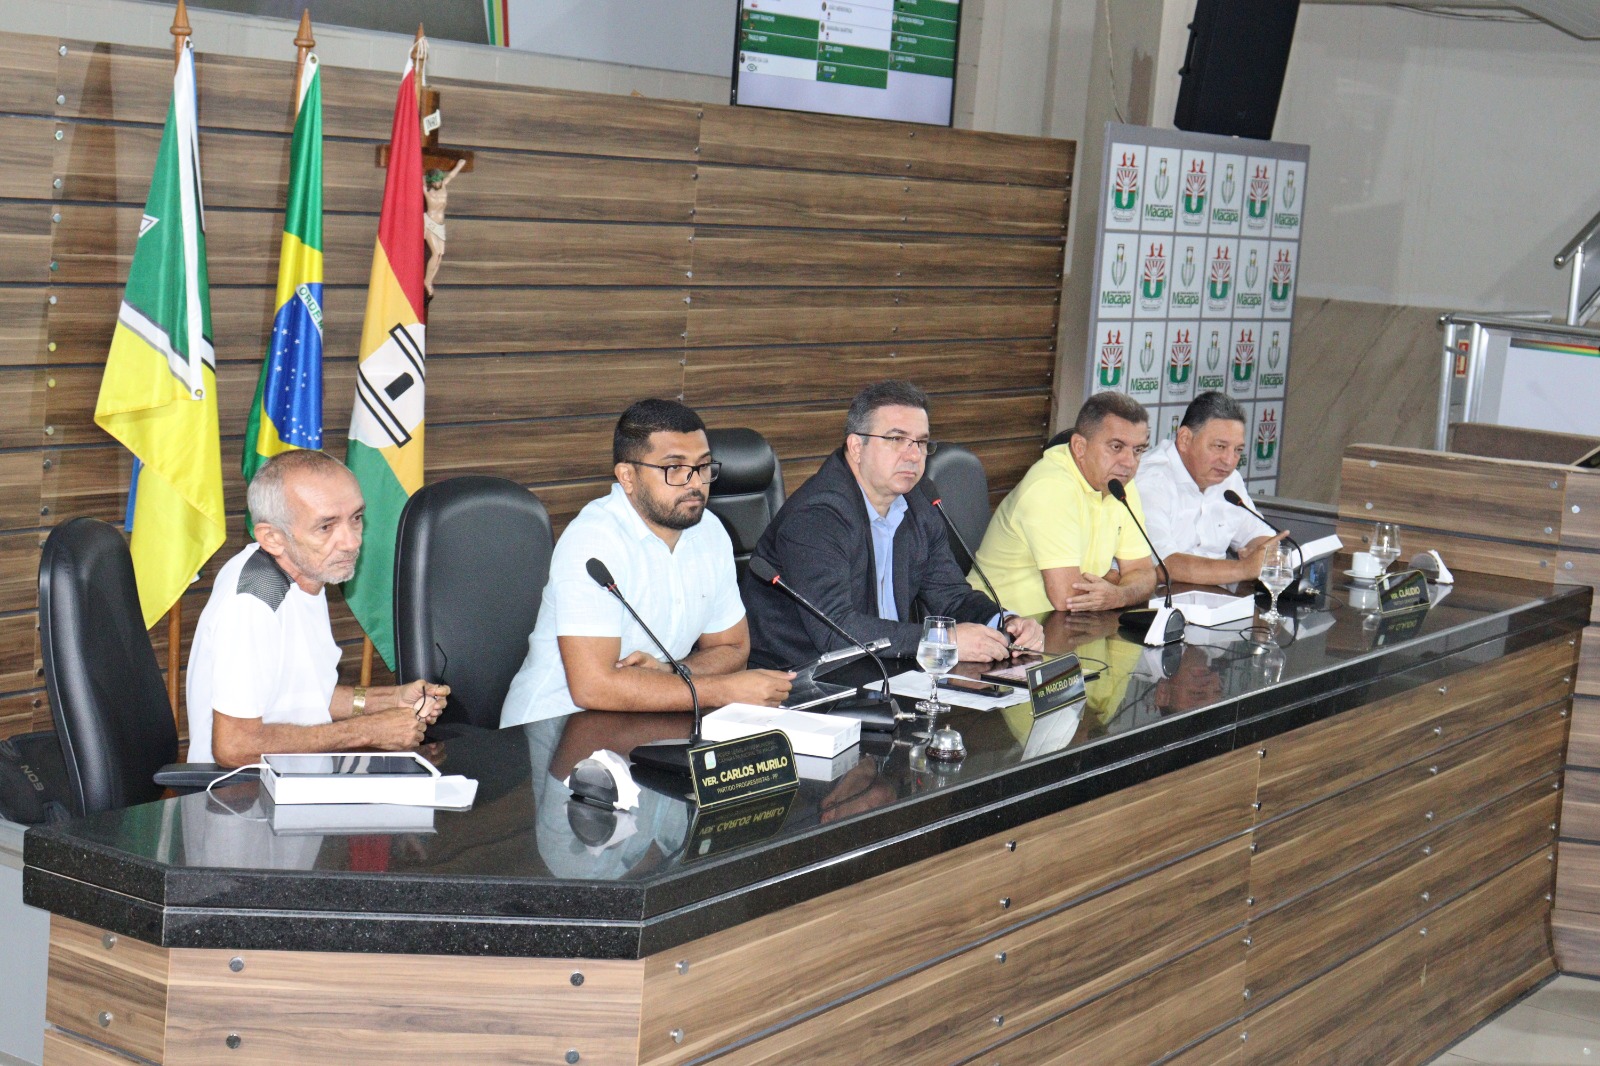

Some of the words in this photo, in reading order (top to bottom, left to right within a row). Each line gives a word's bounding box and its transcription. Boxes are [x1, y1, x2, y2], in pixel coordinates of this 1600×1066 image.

[1045, 680, 1067, 694] MARCELO
[702, 776, 719, 787] VER.
[720, 764, 755, 782] CARLOS
[756, 756, 788, 773] MURILO
[717, 784, 736, 794] PARTIDO
